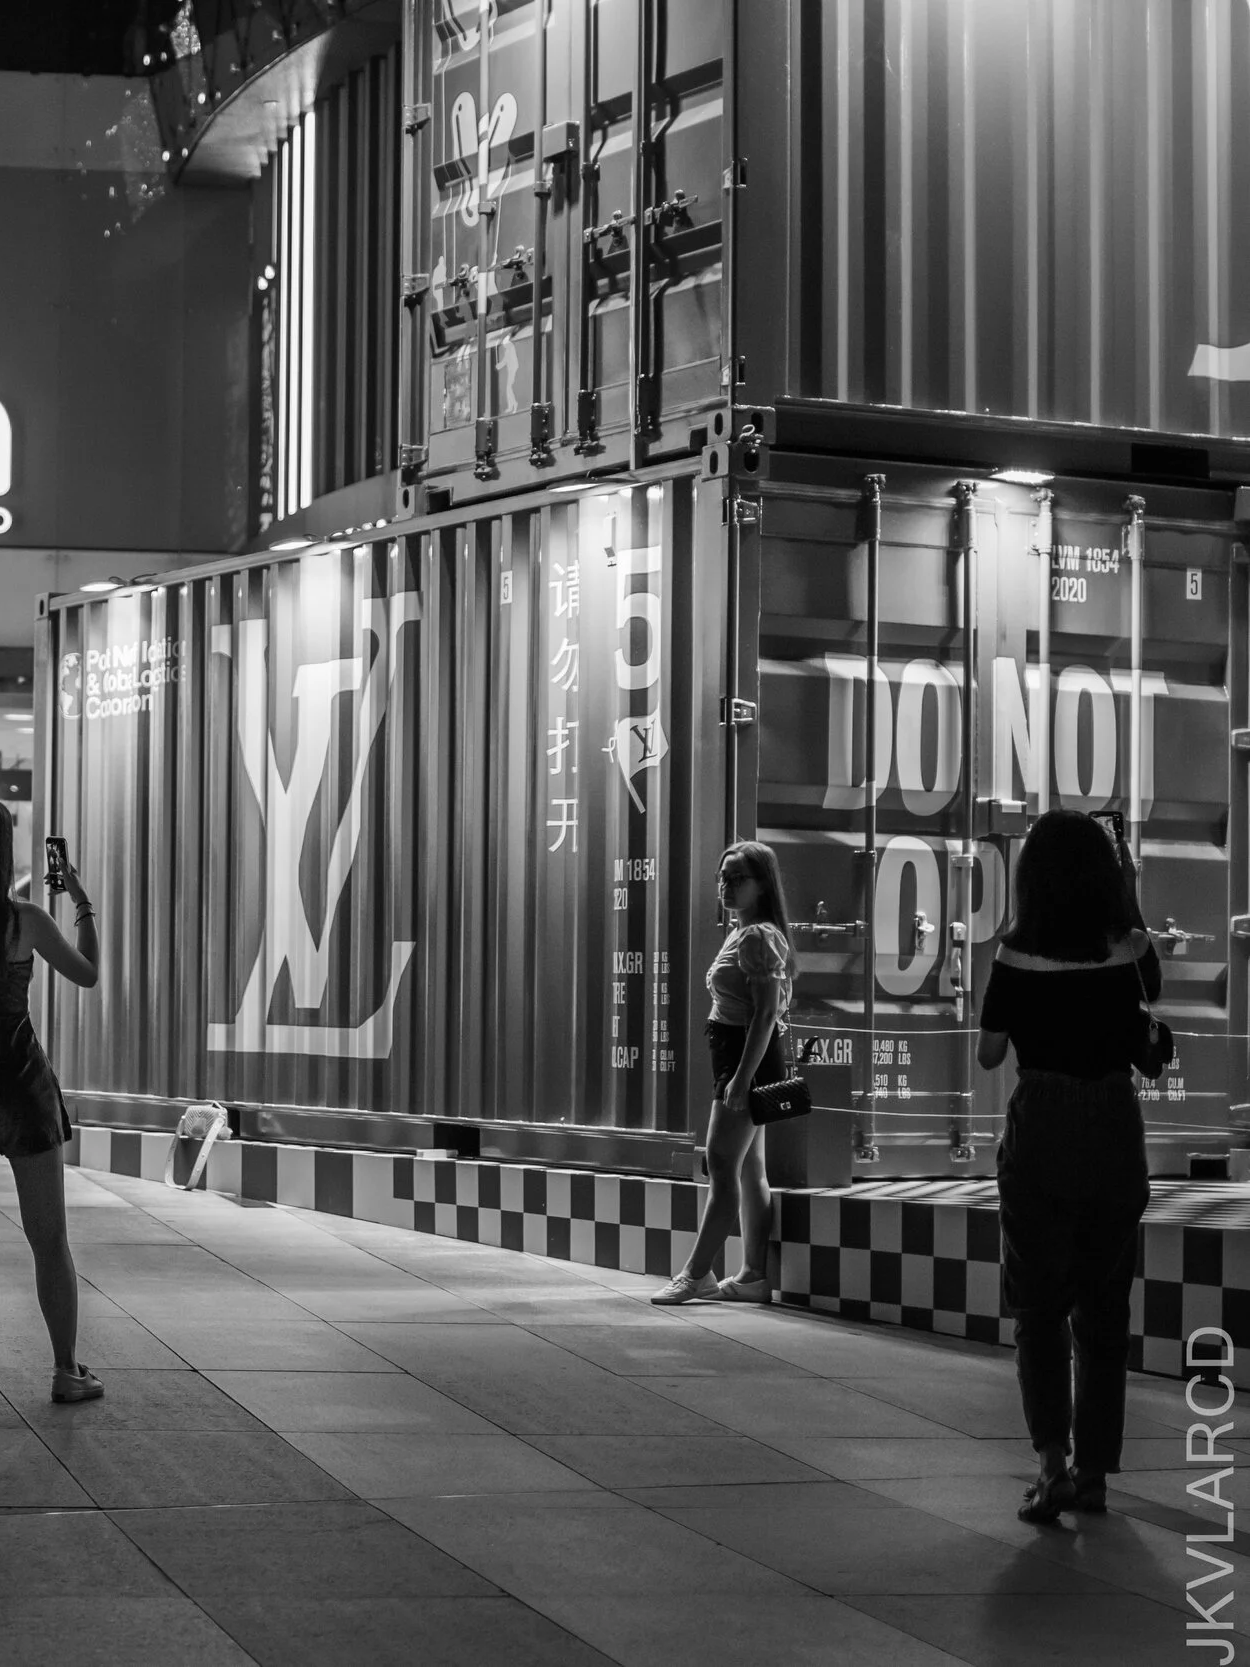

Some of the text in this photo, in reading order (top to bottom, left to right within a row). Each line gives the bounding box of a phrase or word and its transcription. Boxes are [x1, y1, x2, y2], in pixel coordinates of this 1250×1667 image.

[1052, 544, 1120, 574] LVM 1854
[1052, 576, 1087, 602] 2020
[1190, 573, 1198, 595] 5
[616, 545, 661, 691] 5
[86, 673, 101, 697] &
[823, 651, 1169, 822] DO NOT
[626, 858, 656, 881] 1854
[898, 1041, 908, 1053] KG
[898, 1053, 911, 1065] LBS
[873, 1074, 908, 1088] ,510 KG
[897, 1087, 911, 1099] LBS
